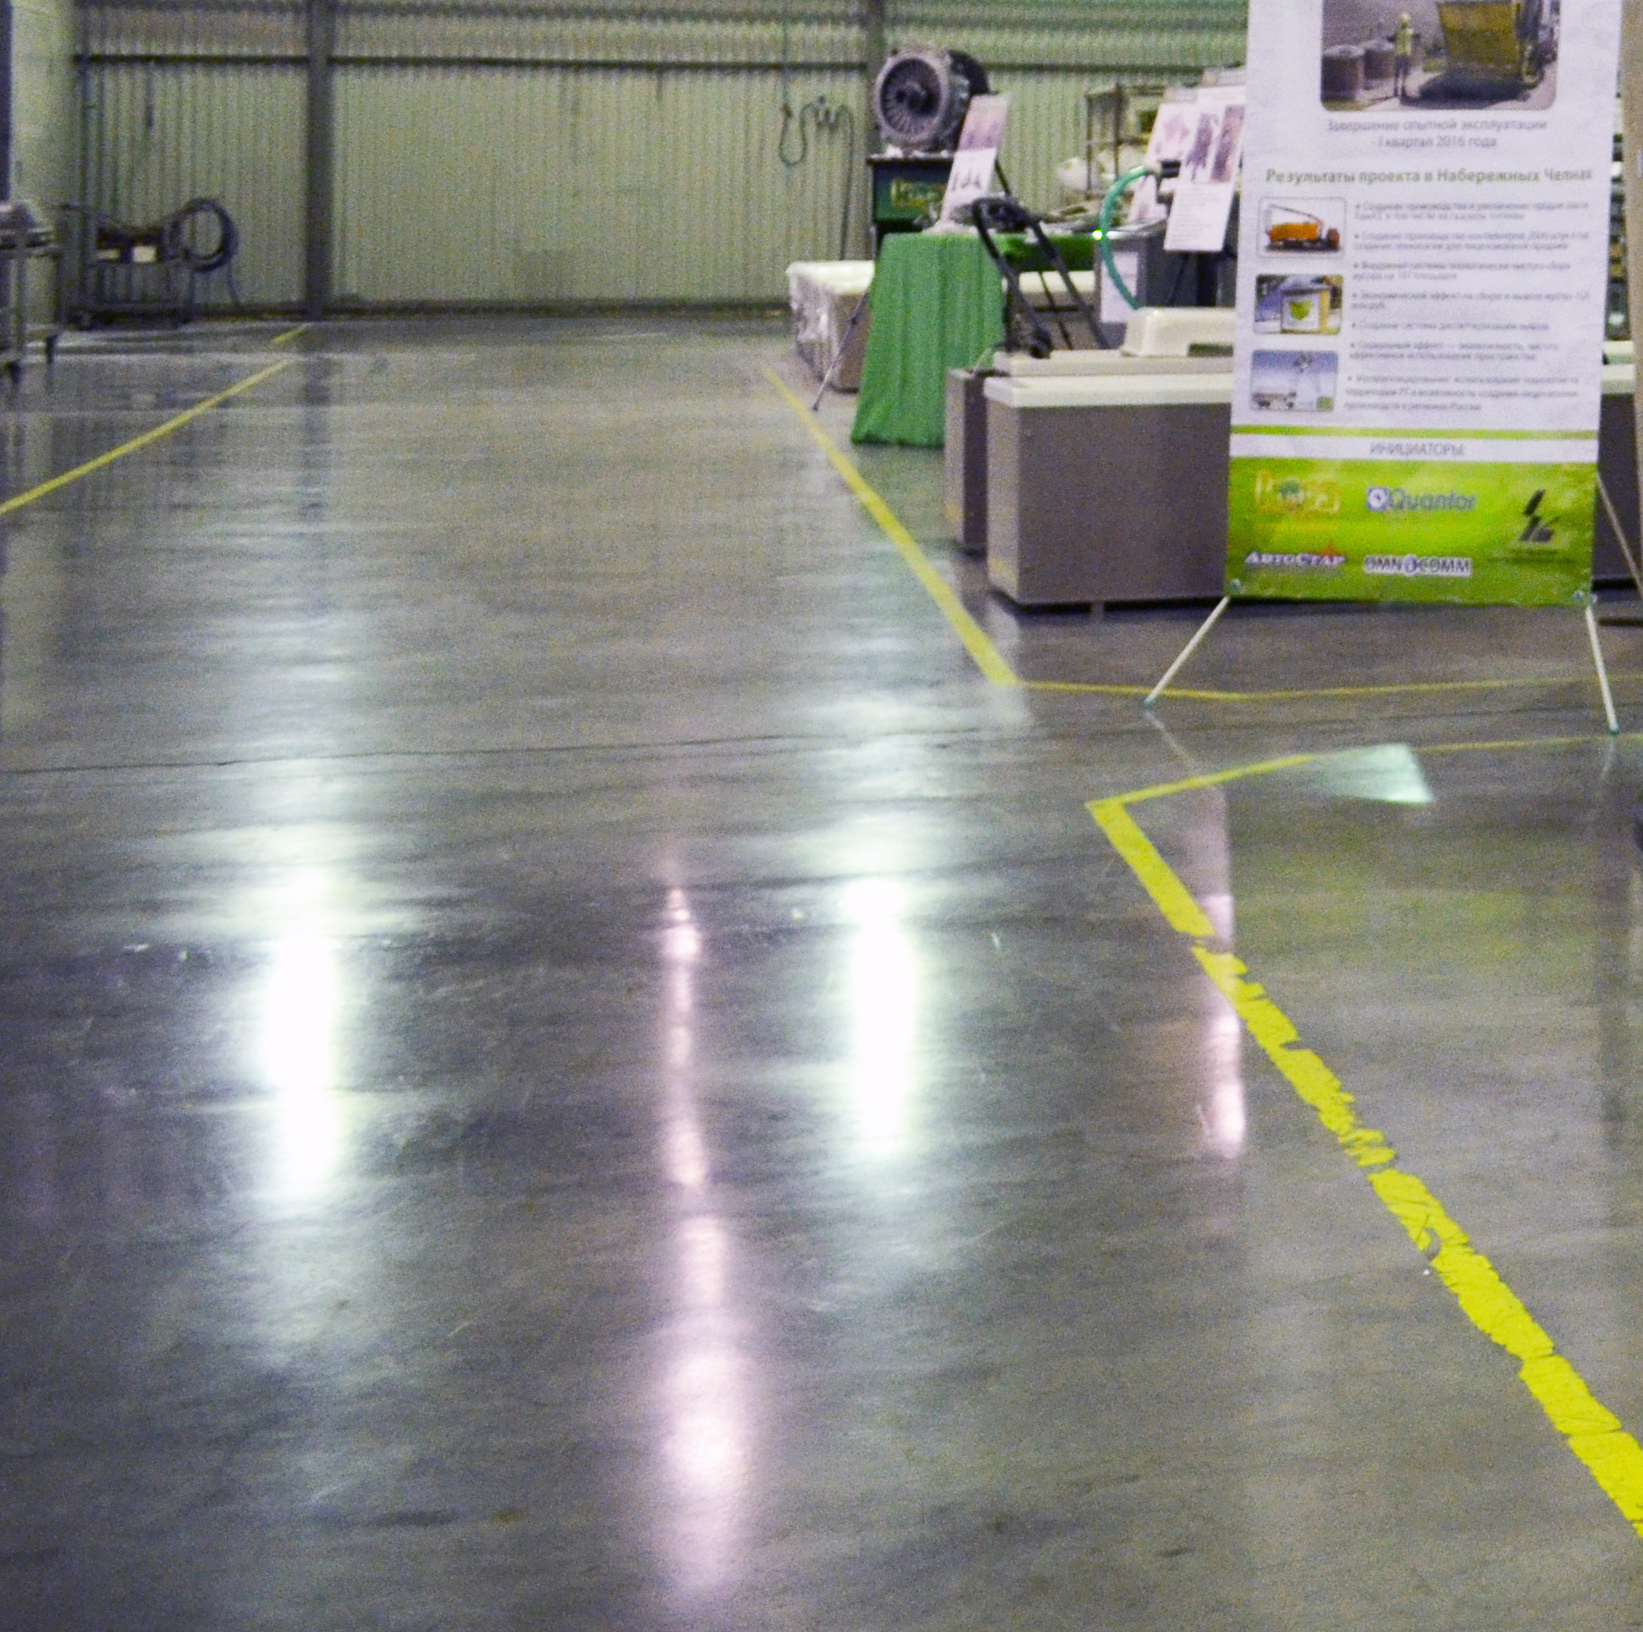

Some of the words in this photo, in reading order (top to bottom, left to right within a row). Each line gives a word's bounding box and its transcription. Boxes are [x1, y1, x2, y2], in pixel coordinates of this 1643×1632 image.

[1436, 136, 1466, 148] 2016
[1266, 169, 1356, 186] Результаты
[1359, 171, 1421, 186] проекта
[1437, 168, 1541, 185] Набережных
[1369, 441, 1465, 457] ИНИЦИАТОРЫ
